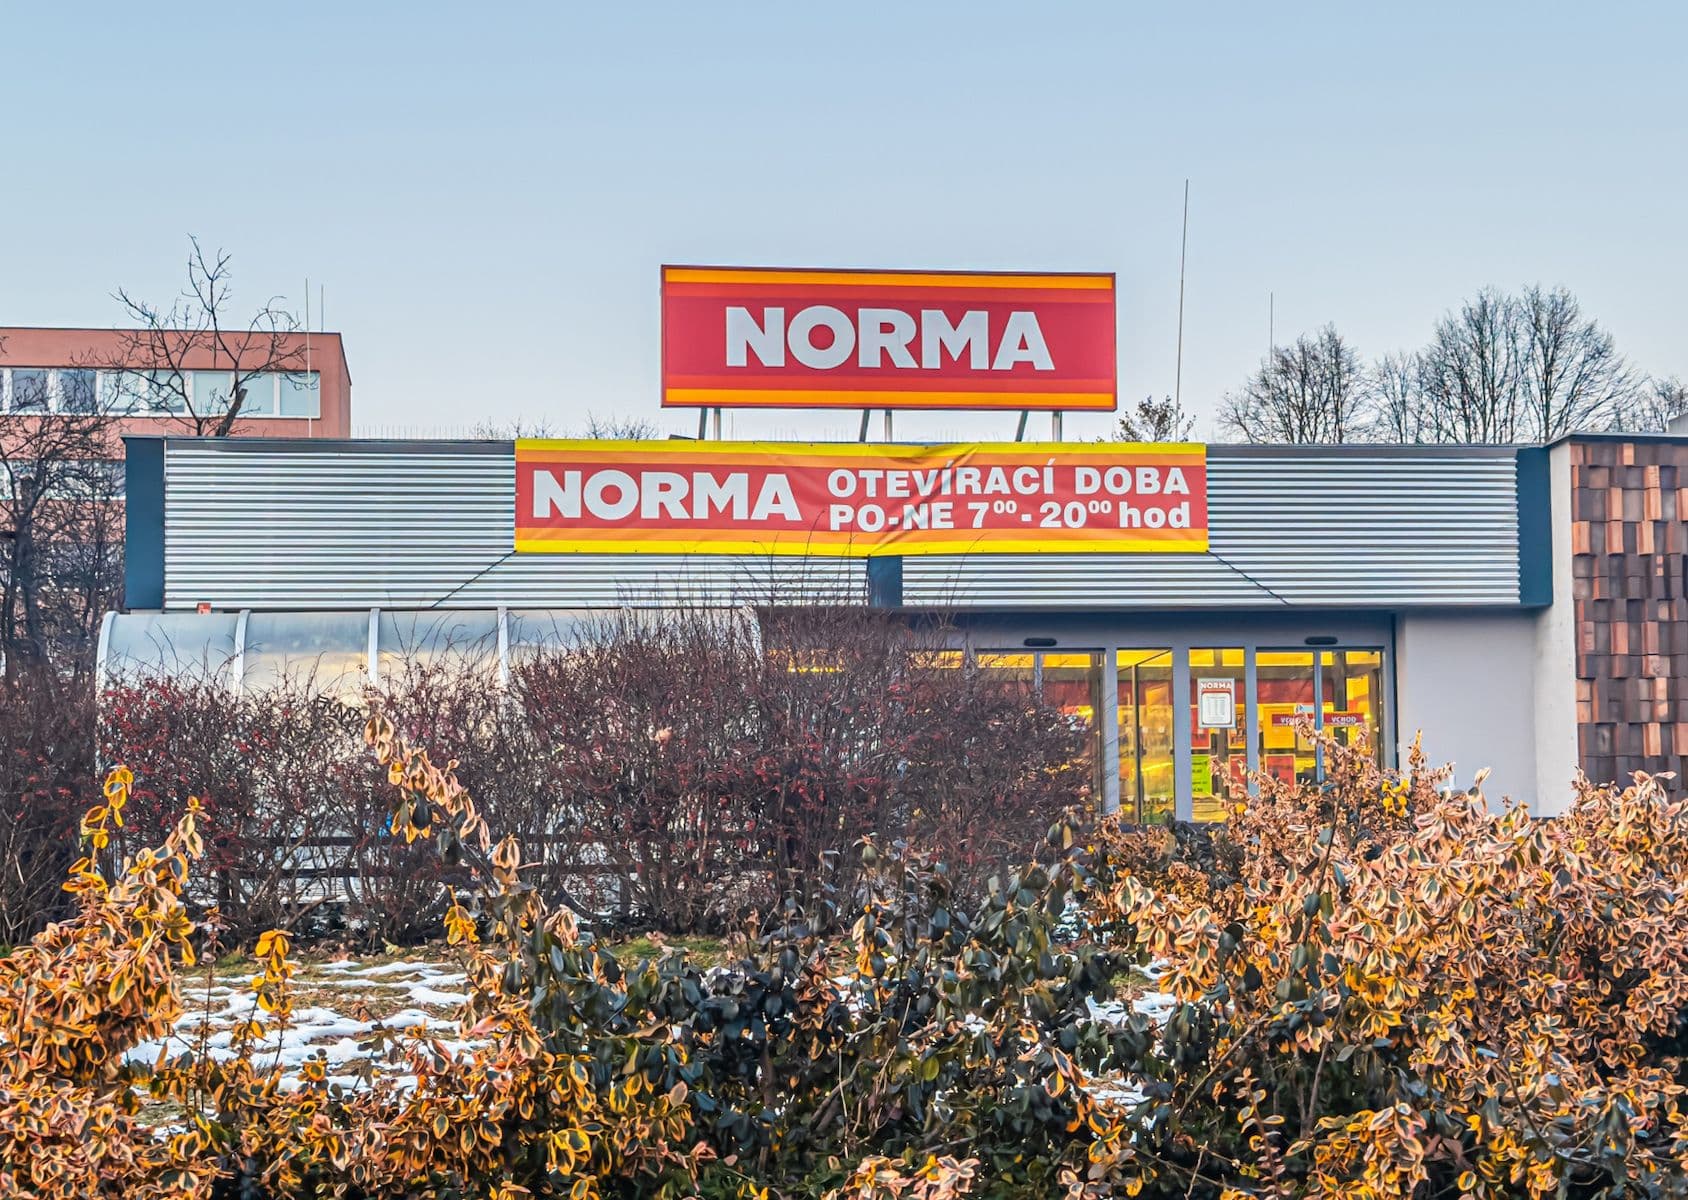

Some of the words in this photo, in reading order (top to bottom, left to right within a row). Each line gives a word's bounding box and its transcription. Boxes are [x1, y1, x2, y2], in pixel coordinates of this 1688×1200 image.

[726, 305, 1055, 370] NORMA
[533, 469, 802, 521] NORMA
[828, 458, 1056, 498] OTEVÍRACÍ
[1074, 467, 1190, 496] DOBA
[829, 502, 954, 532] PO-NE
[1119, 501, 1190, 528] hod
